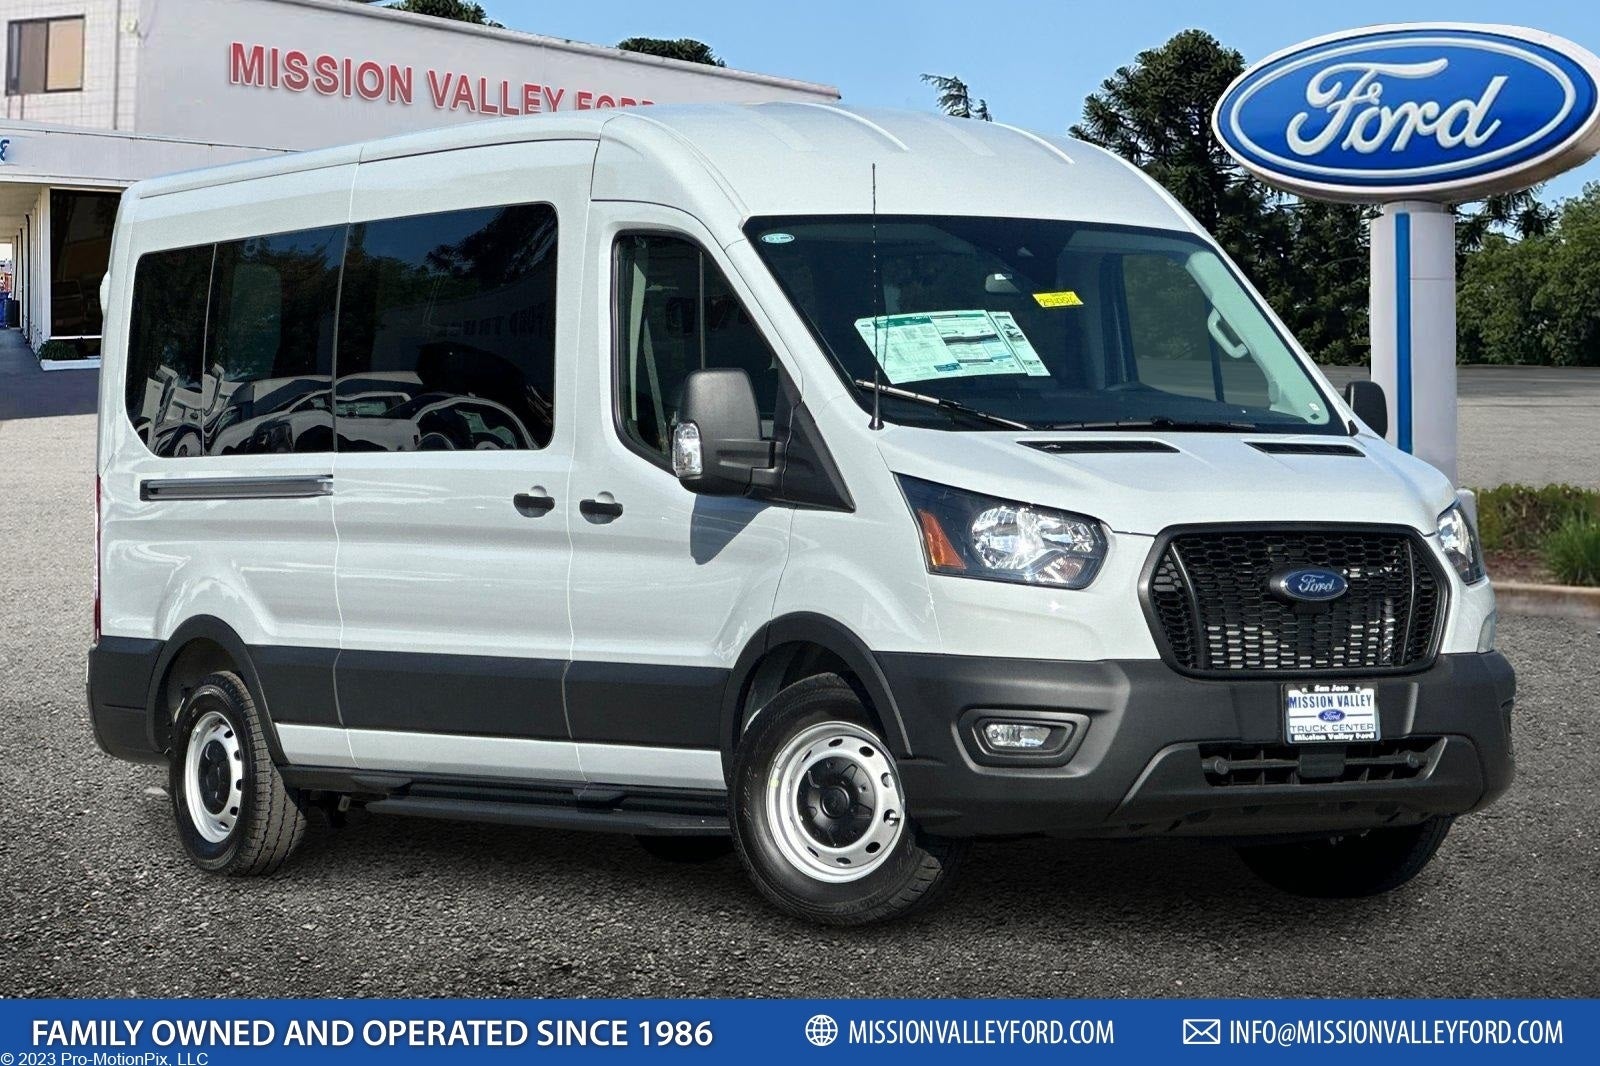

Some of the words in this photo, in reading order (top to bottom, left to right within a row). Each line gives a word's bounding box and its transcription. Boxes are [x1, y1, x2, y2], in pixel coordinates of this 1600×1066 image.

[229, 41, 414, 105] MISSION
[427, 69, 566, 116] VALLEY
[1286, 57, 1509, 157] Ford
[1297, 573, 1335, 593] Ford
[1289, 695, 1334, 709] MISSION
[1337, 694, 1372, 707] VALLEY
[1322, 711, 1341, 721] Ford
[1291, 724, 1327, 733] TRUCK
[1331, 723, 1374, 732] CENTER
